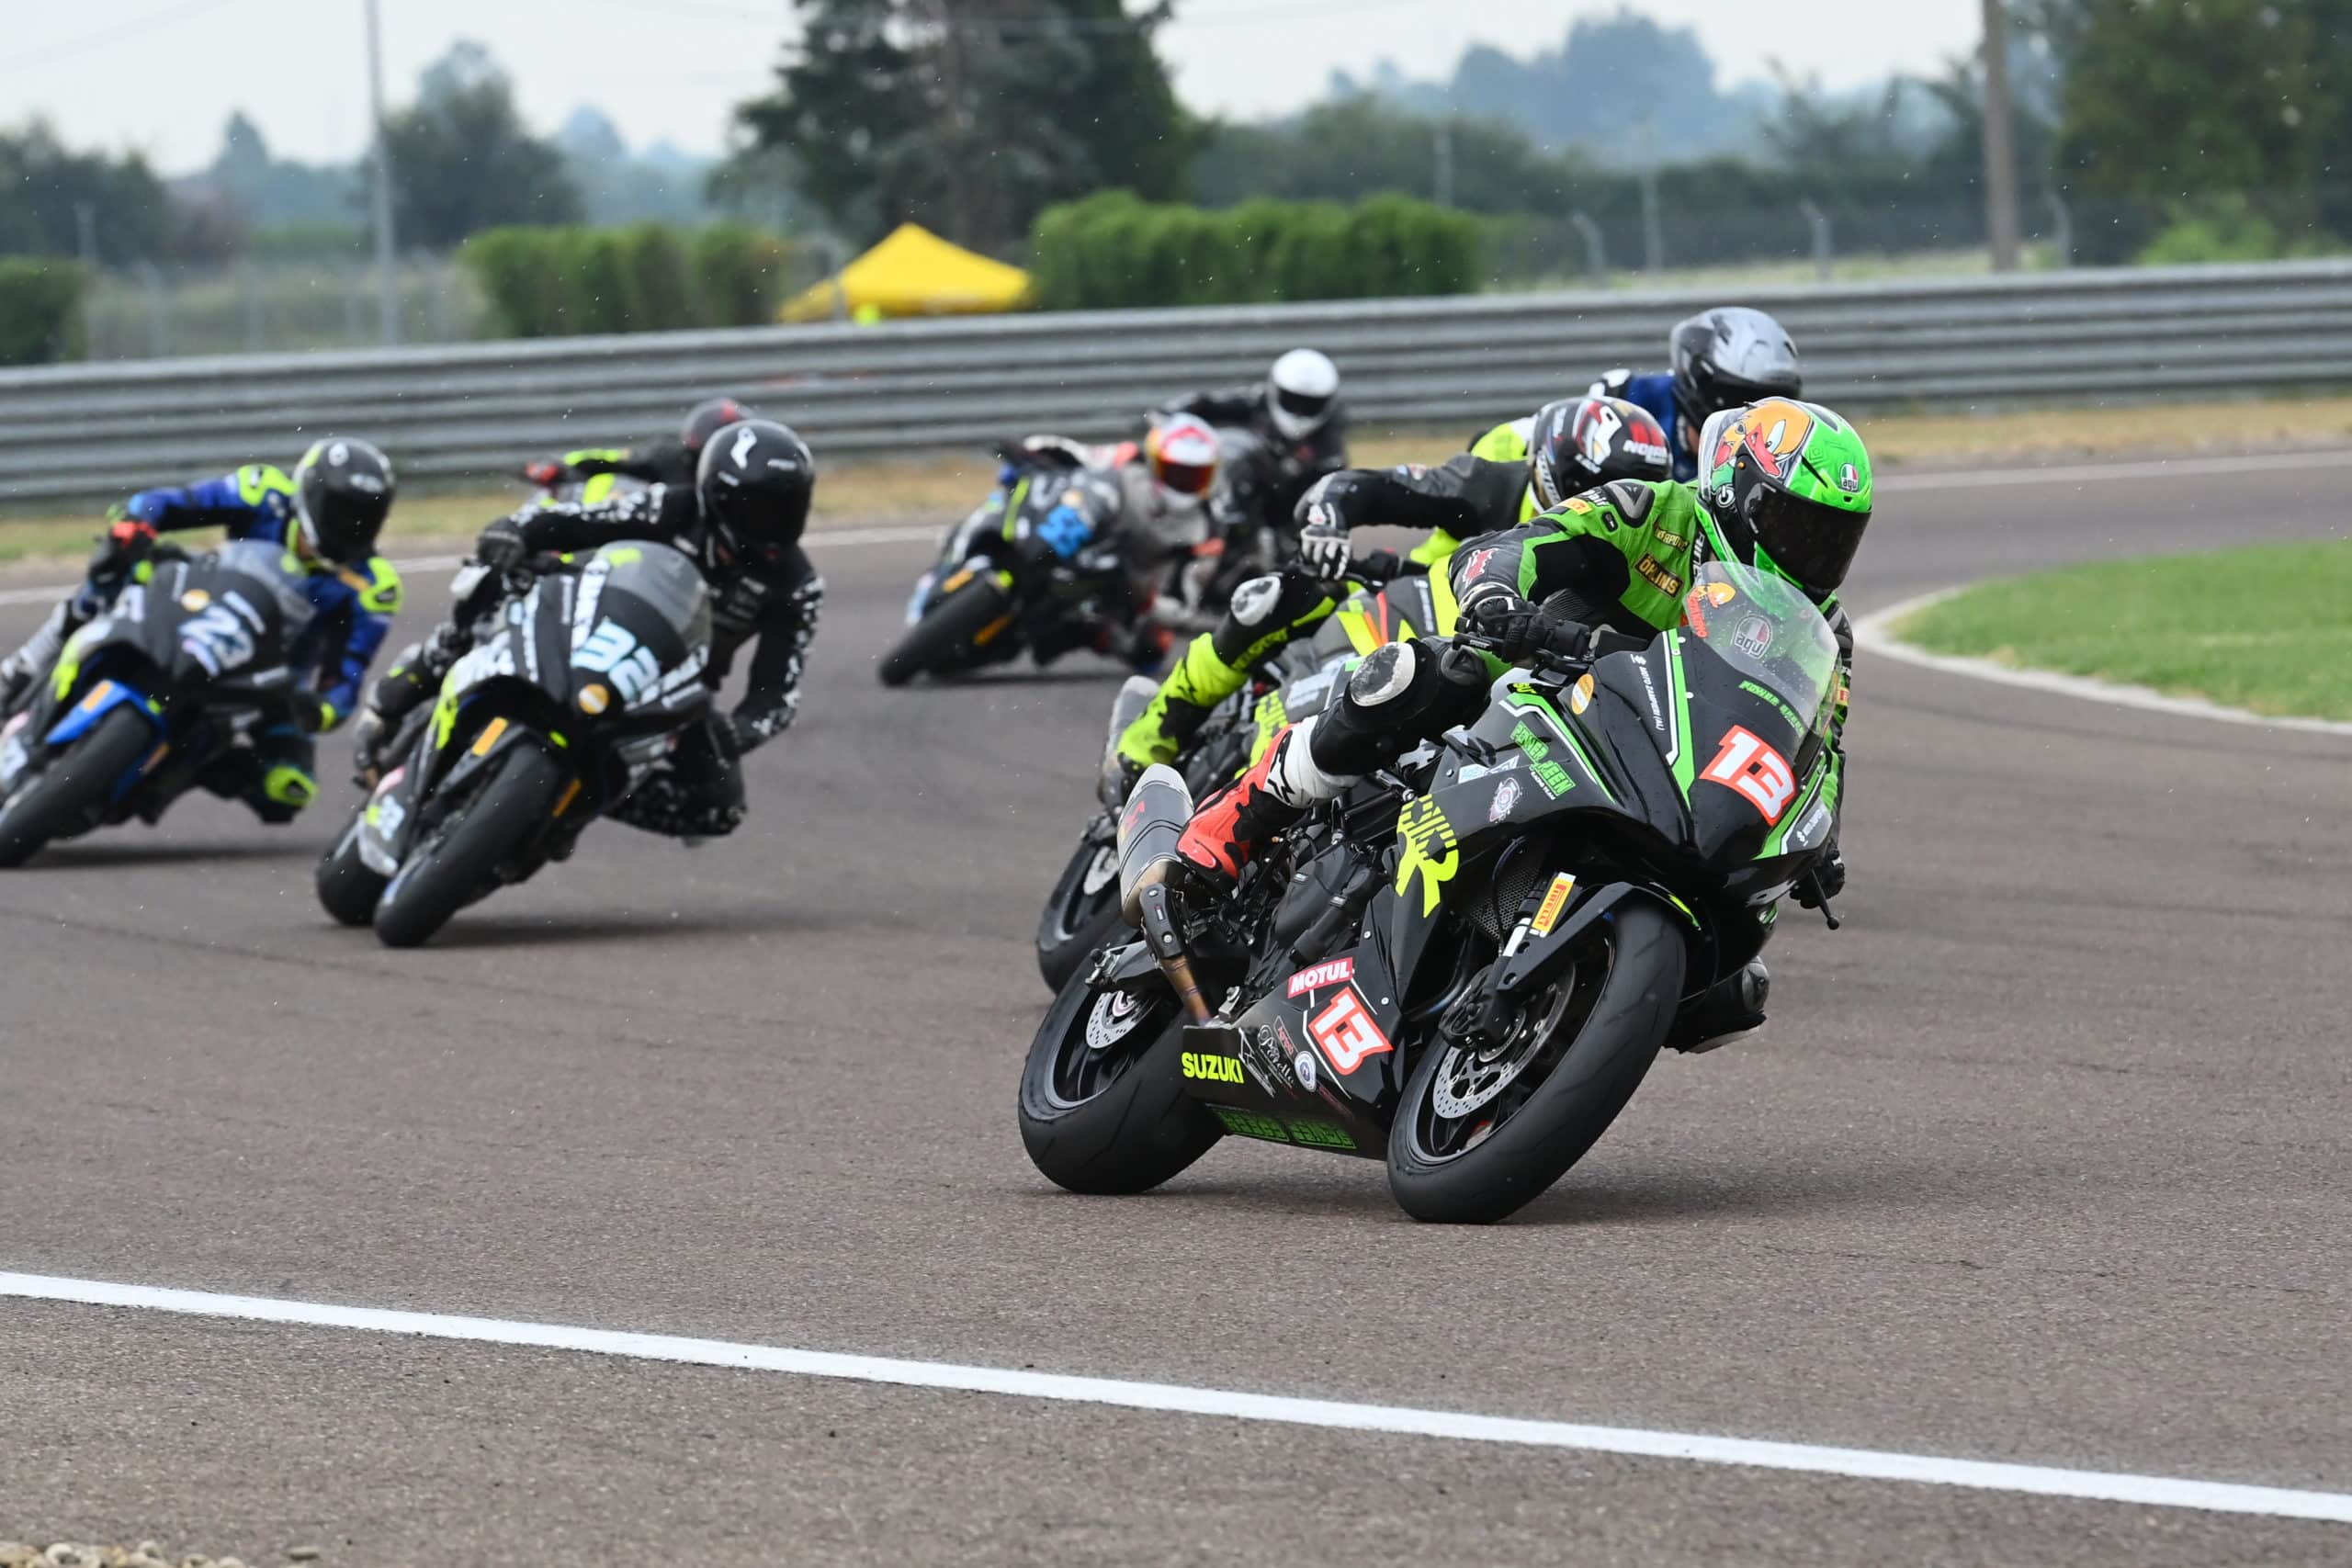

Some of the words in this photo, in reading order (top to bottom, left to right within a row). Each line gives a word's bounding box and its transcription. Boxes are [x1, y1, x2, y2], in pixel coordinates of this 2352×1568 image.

[1638, 556, 1679, 595] ÖHINS
[570, 615, 662, 702] 32
[1510, 720, 1550, 764] POWER
[1709, 729, 1795, 819] 13
[1290, 960, 1351, 995] MOTUL
[1314, 993, 1384, 1069] 13
[1182, 1052, 1245, 1084] SUZUKI
